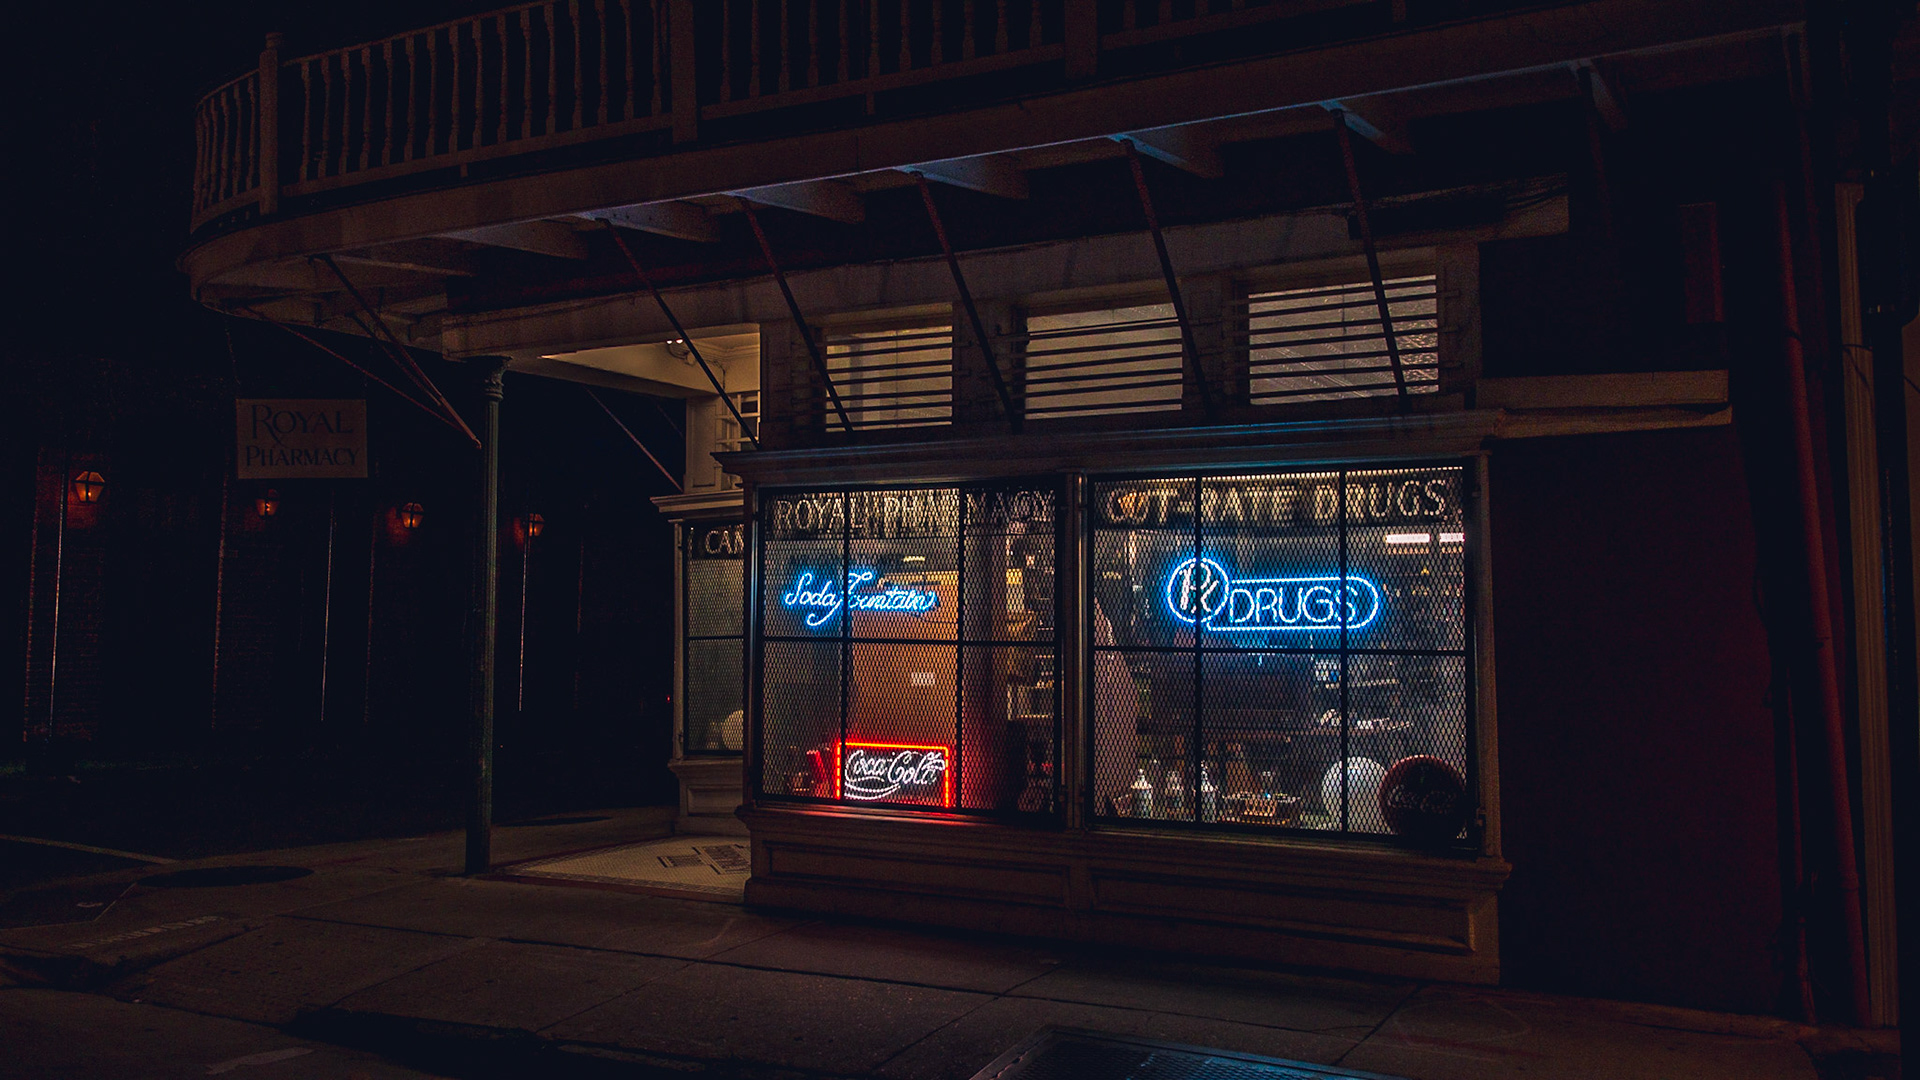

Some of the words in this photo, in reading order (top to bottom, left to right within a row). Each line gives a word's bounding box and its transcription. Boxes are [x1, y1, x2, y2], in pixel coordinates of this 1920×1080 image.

[251, 404, 353, 448] ROYAL
[246, 445, 358, 466] PHARMACY
[777, 498, 864, 531] ROYAL
[883, 489, 1054, 528] PHAMACY
[1314, 479, 1446, 519] DRUGS
[785, 572, 838, 606] Soda
[807, 571, 936, 626] Fountain
[1229, 586, 1358, 623] DRUGS
[845, 750, 946, 785] Coca-Cola
